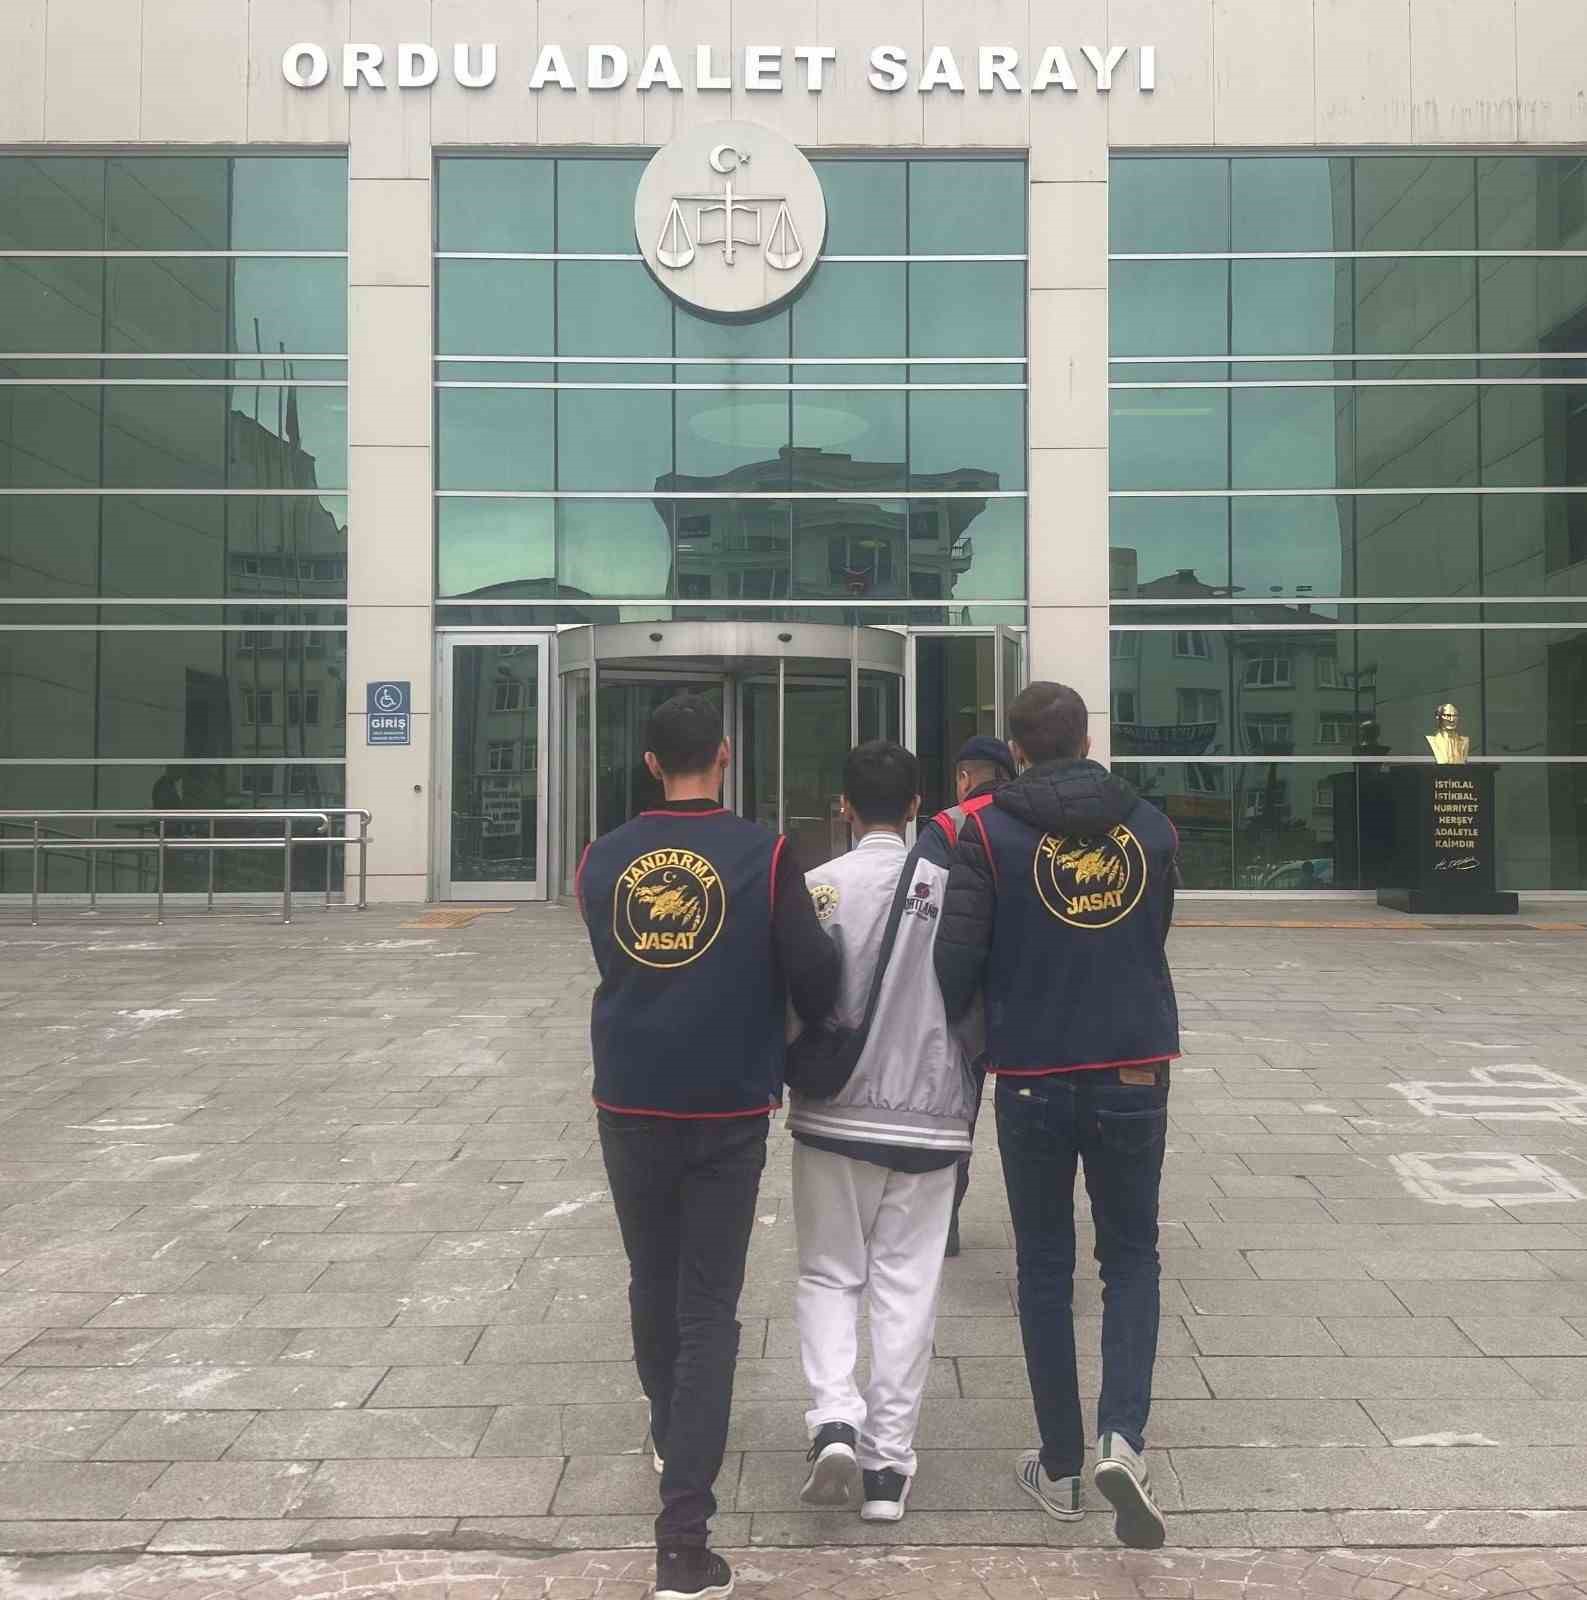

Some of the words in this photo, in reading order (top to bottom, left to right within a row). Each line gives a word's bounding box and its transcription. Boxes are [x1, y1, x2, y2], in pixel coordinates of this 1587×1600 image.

[282, 43, 498, 89] ORDU
[528, 44, 837, 92] ADALET
[868, 45, 1157, 93] SARAYI
[371, 717, 406, 730] GİRİŞ
[623, 852, 716, 889] JANDARMA
[1066, 889, 1124, 915] JASAT
[634, 932, 699, 950] JASAT
